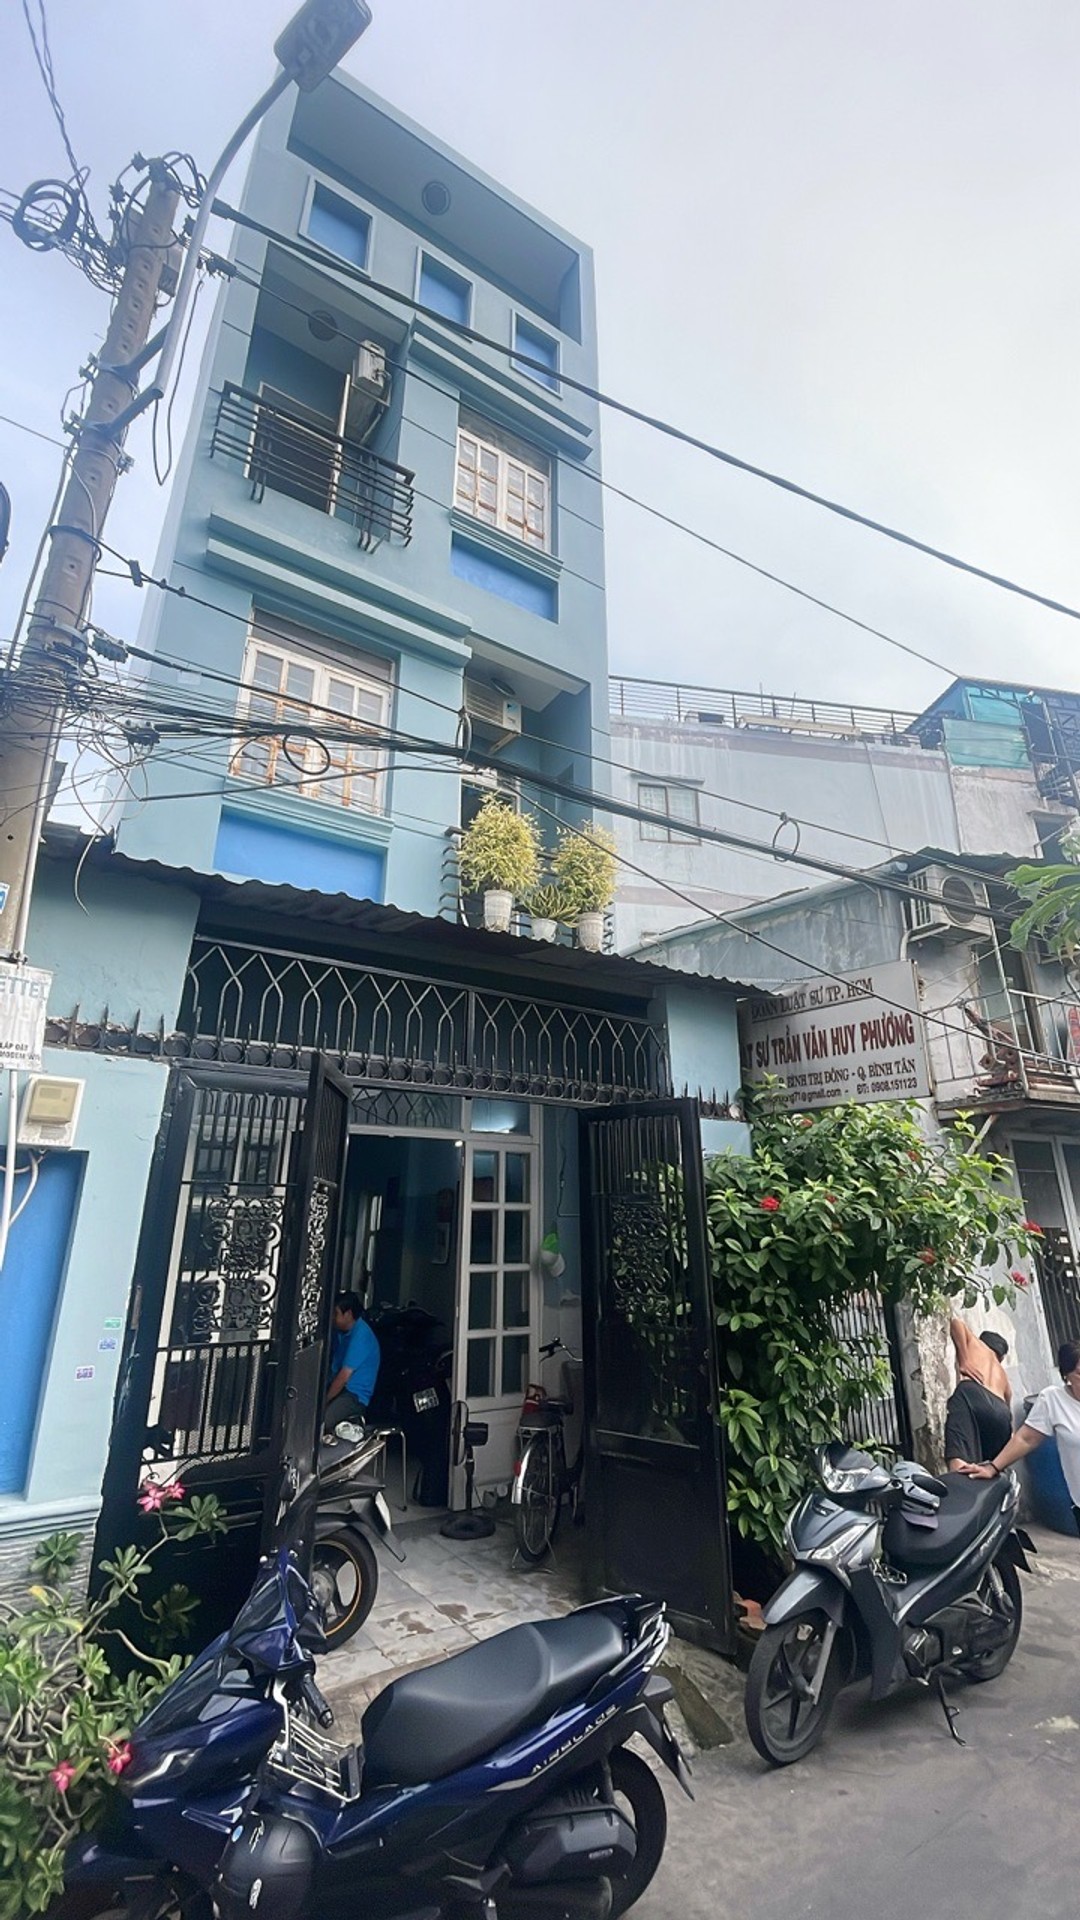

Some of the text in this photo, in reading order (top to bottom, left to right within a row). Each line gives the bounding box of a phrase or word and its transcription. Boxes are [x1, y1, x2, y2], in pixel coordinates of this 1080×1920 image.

[825, 984, 844, 1002] TP.
[756, 1034, 770, 1068] SƯ
[802, 1024, 828, 1060] VĂN
[831, 1024, 856, 1056] HUY
[859, 1011, 915, 1052] PHƯƠNG
[868, 1061, 894, 1078] BÌNH
[894, 1057, 916, 1075] TÂN
